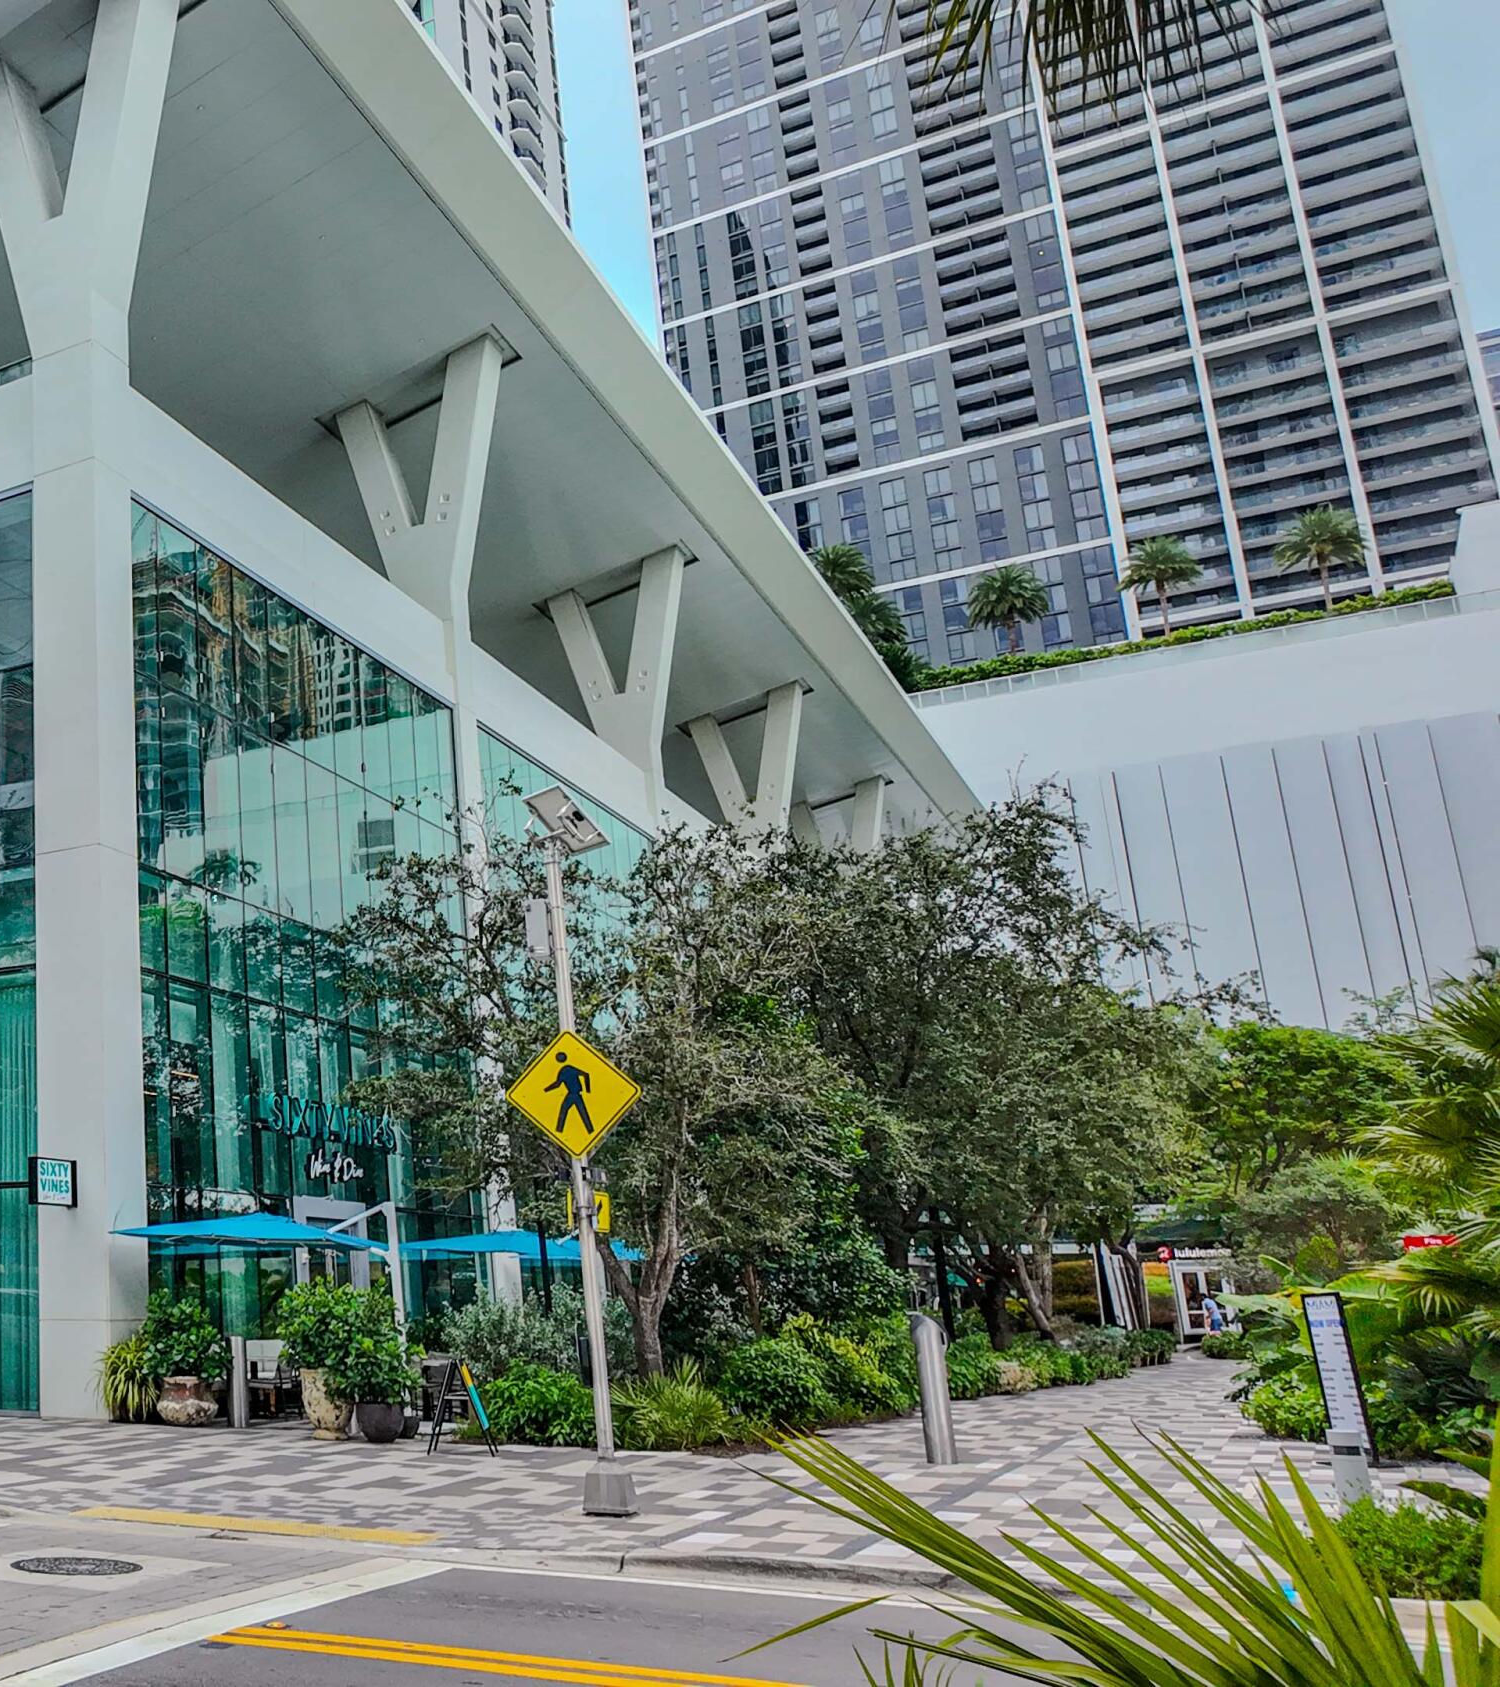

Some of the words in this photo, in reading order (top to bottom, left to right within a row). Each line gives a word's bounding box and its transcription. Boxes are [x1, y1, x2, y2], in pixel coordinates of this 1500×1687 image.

[270, 1094, 336, 1141] SIXTY
[40, 1161, 69, 1177] SIXTY
[40, 1178, 70, 1193] VINES
